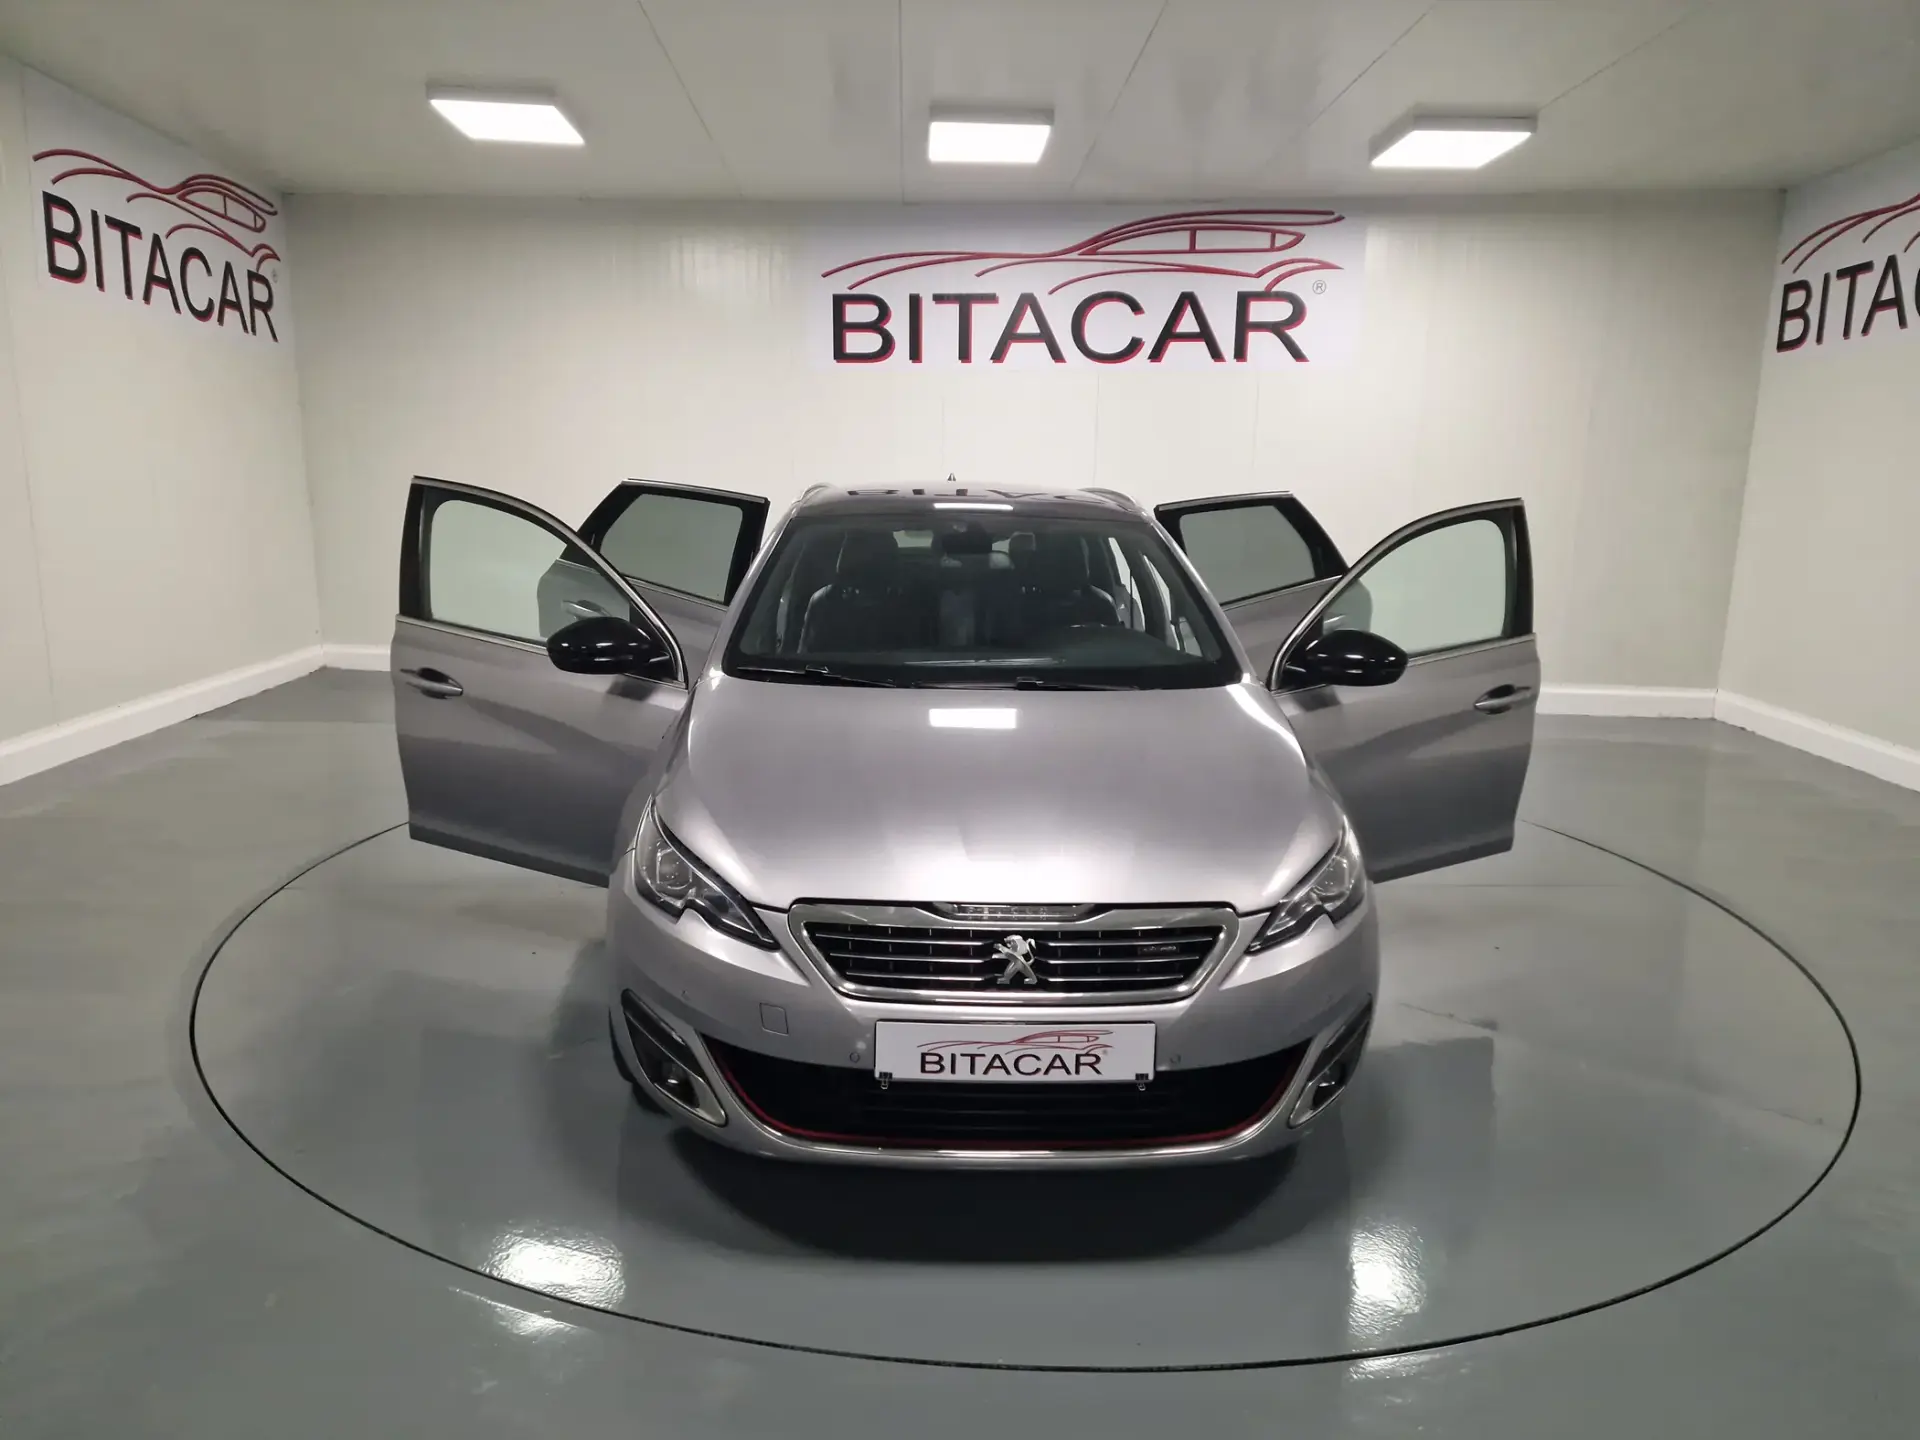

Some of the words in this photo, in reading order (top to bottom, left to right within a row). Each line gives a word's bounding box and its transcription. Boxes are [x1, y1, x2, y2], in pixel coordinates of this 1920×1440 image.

[42, 190, 278, 343] BITACAR
[1776, 254, 1920, 353] BITA
[832, 290, 1310, 363] BITACAR
[920, 1052, 1103, 1076] BITACAR
